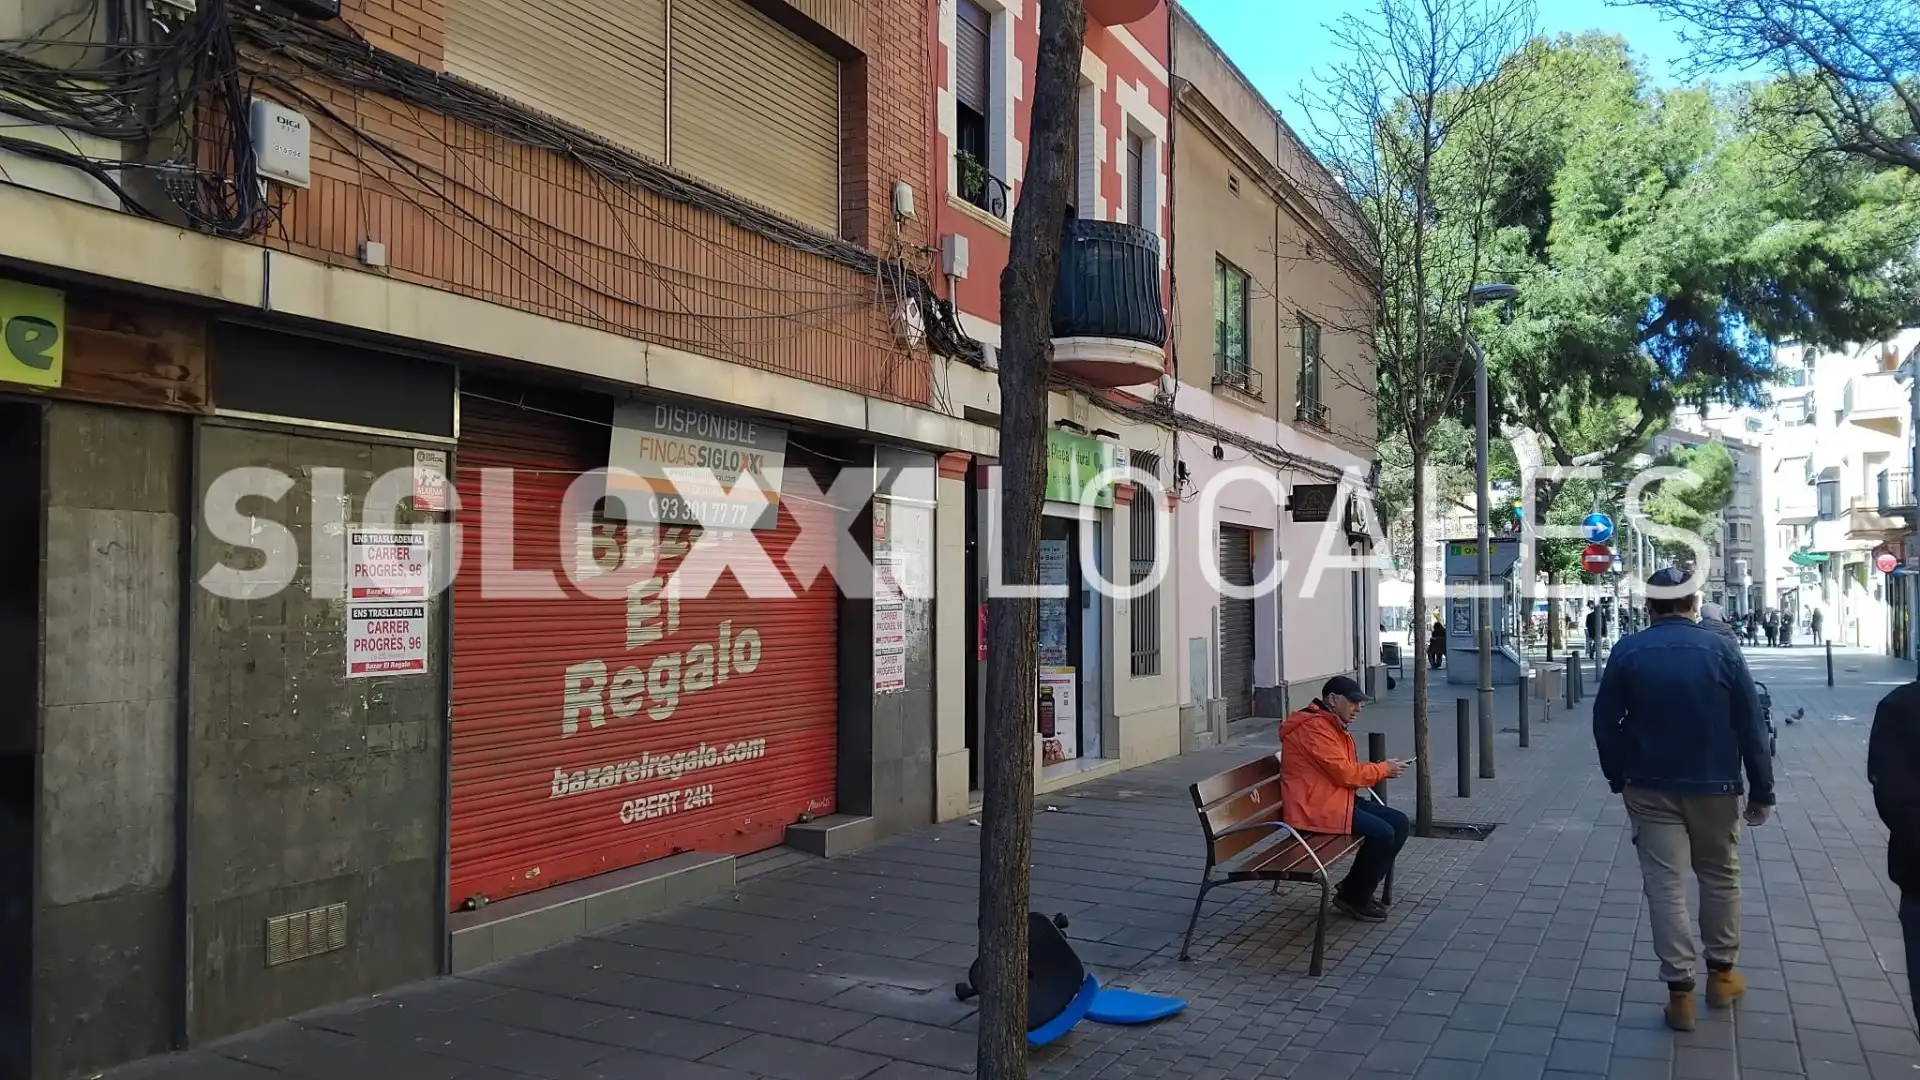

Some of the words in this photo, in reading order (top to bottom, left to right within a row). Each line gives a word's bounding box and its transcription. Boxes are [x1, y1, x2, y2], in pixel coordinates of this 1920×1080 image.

[276, 116, 300, 129] DIGI
[654, 404, 758, 445] DISPONIBLE
[1070, 448, 1090, 466] tural
[660, 497, 679, 520] 93
[681, 500, 706, 522] 301
[712, 503, 728, 523] 77
[731, 504, 748, 524] 77
[353, 534, 368, 543] ENS
[368, 534, 412, 544] TRASLLADEM
[413, 534, 423, 544] AL
[367, 547, 410, 560] CARRER
[574, 522, 734, 582] Baz
[354, 561, 407, 577] PROGRÈS,
[409, 563, 422, 577] 96
[353, 608, 368, 617] ENS
[368, 608, 413, 617] TRASLLADEM
[414, 608, 423, 617] AL
[625, 571, 681, 651] El
[367, 620, 409, 634] CARRER
[354, 634, 406, 652] PROGRÈS,
[409, 636, 422, 650] 96
[561, 619, 762, 739] Regalo
[549, 738, 766, 799] bazarelregalo.com
[619, 791, 681, 824] OBERT
[683, 784, 713, 811] 24H
